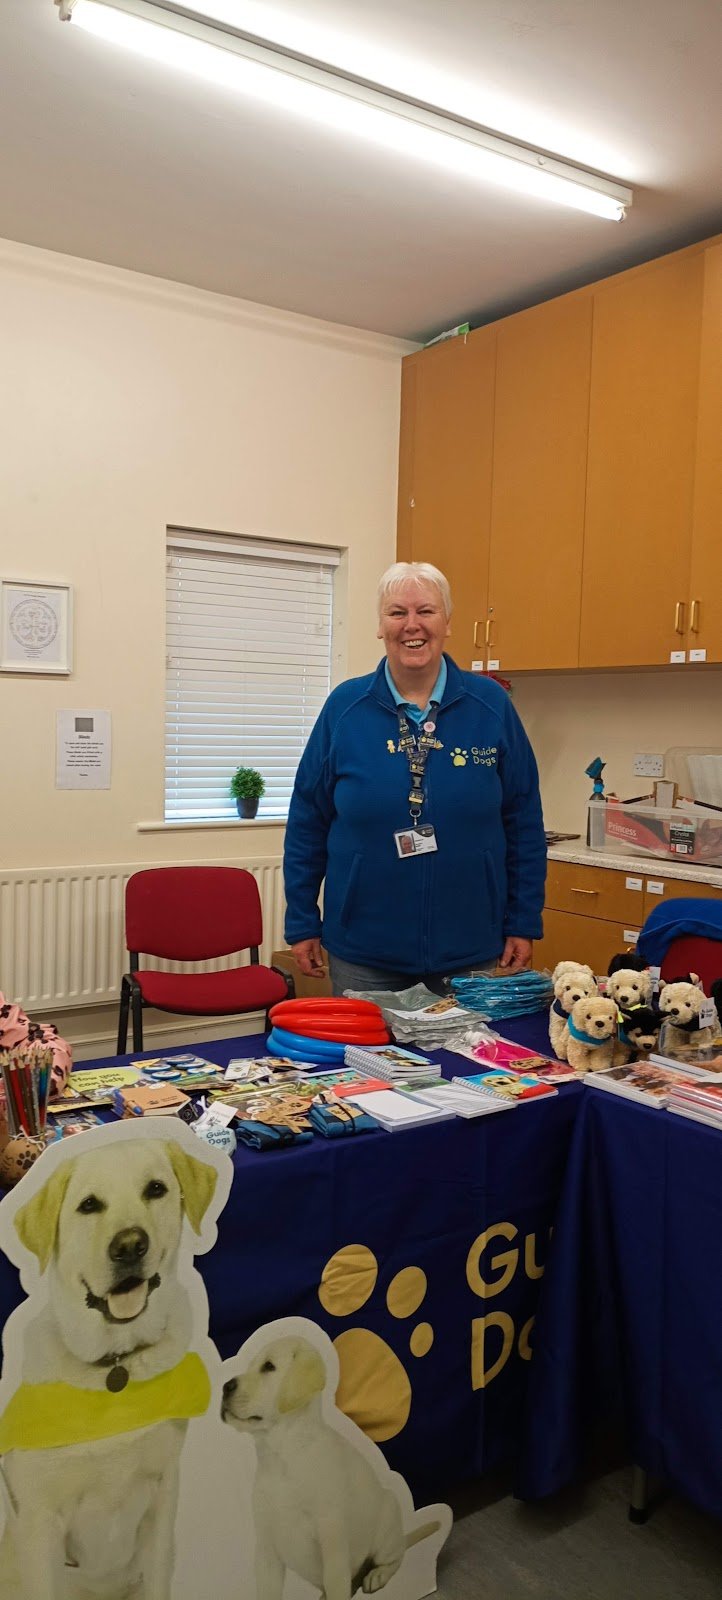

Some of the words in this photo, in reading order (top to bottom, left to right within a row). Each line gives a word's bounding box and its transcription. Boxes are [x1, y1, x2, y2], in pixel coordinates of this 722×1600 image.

[471, 746, 498, 756] Guide
[473, 756, 496, 767] Dogs
[607, 822, 637, 837] Princess
[206, 1130, 230, 1139] Guide
[208, 1137, 231, 1145] Dogs
